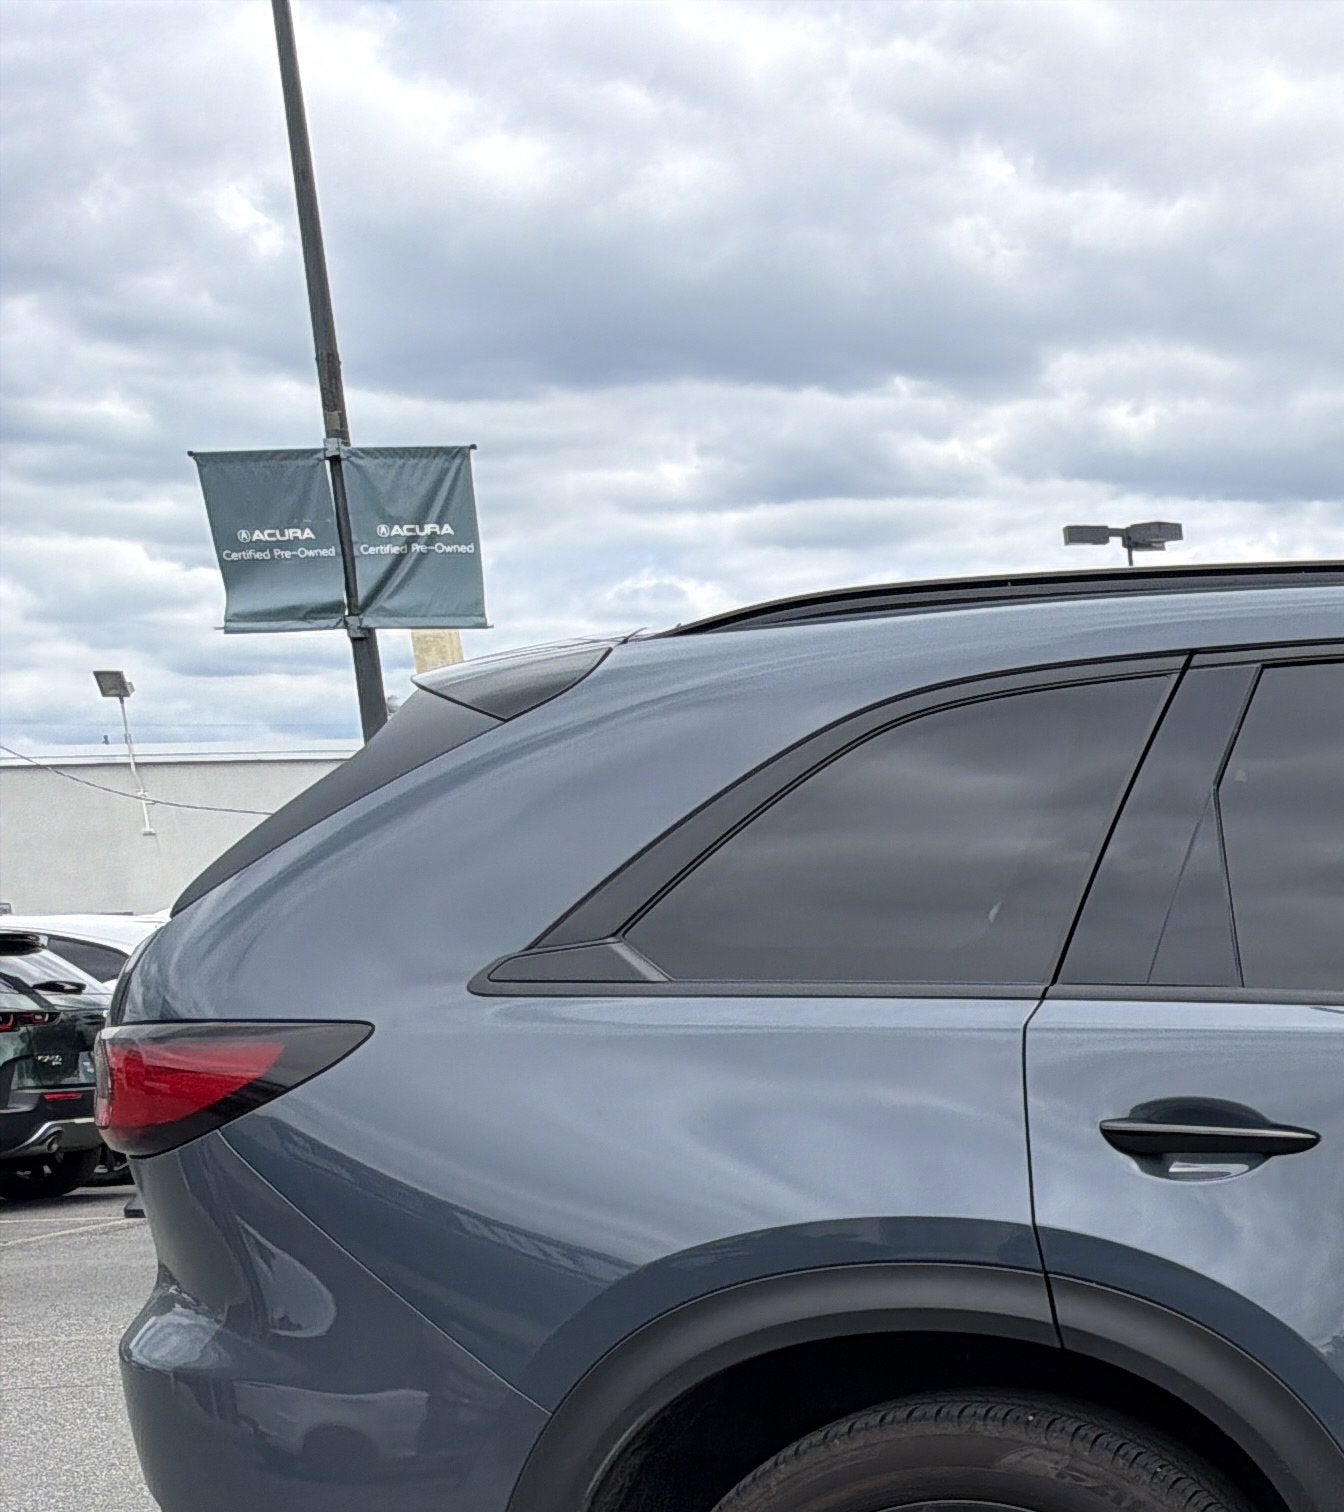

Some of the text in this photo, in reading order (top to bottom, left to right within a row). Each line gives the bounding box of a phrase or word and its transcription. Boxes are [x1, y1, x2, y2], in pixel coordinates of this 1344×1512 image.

[252, 527, 316, 542] ACURA
[390, 522, 455, 537] ACURA
[222, 545, 336, 561] Certified Pre-Owned
[360, 541, 475, 556] Certified Pre-Owned
